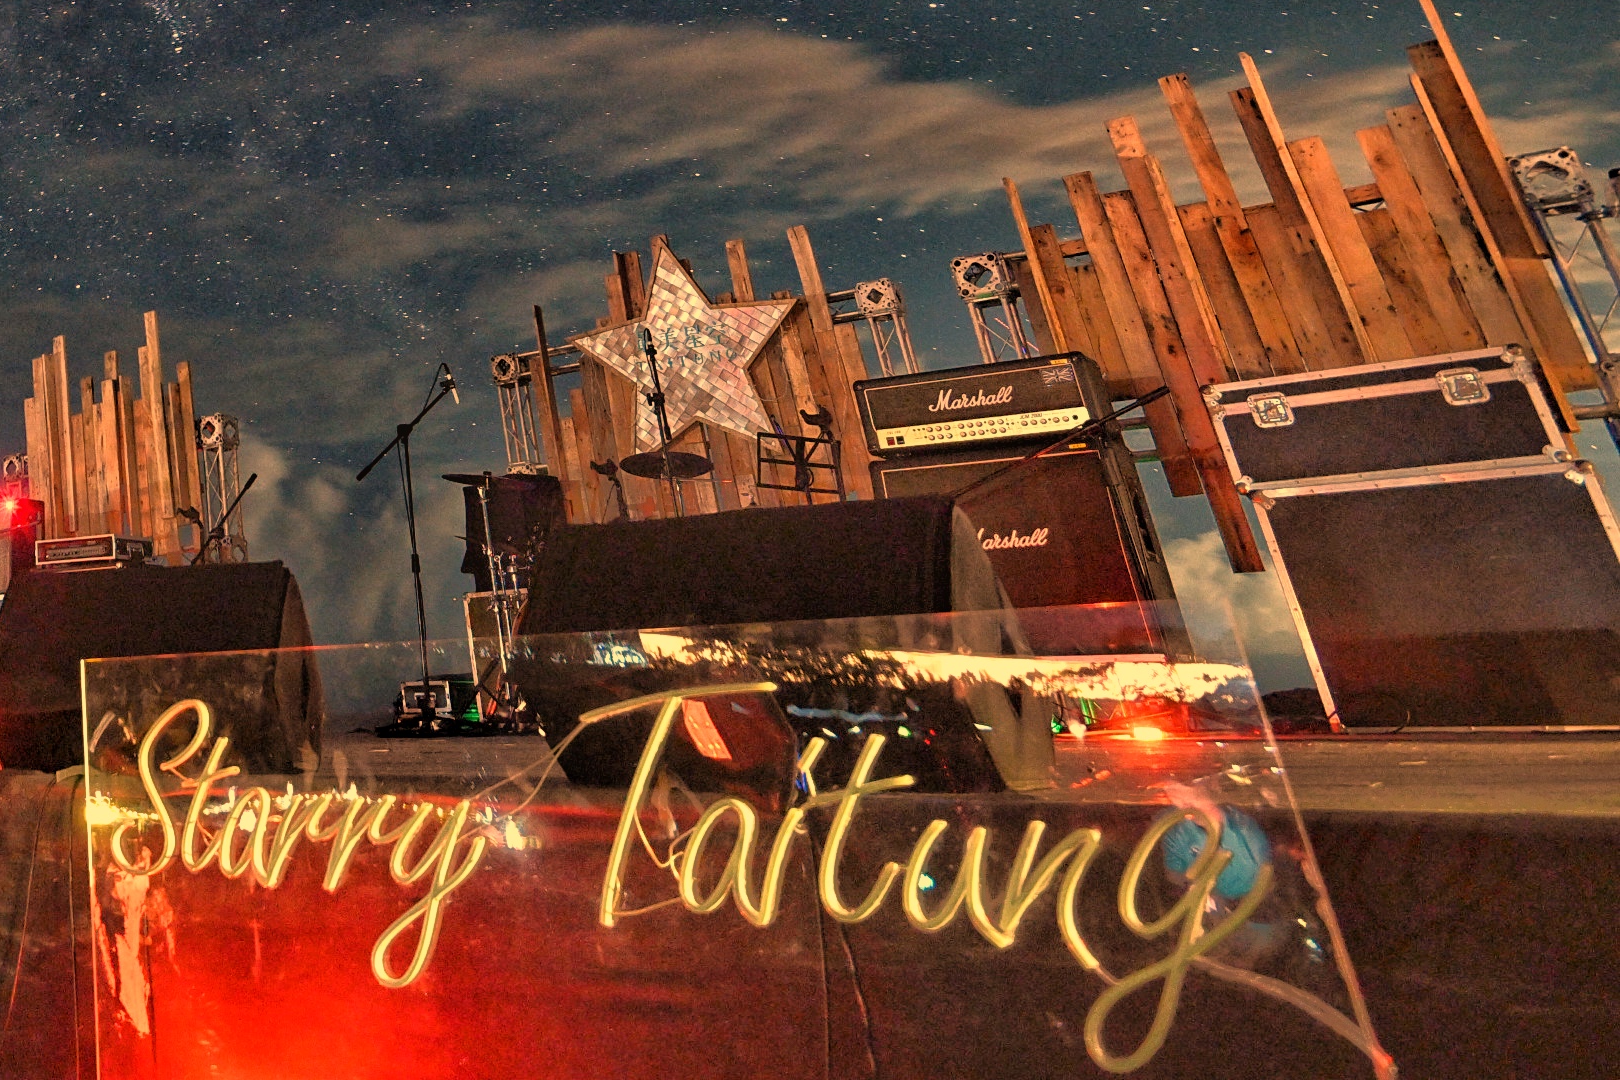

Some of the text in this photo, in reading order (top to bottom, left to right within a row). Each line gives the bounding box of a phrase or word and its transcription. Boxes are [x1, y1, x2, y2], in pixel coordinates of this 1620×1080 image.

[928, 385, 1013, 413] Marshall
[977, 527, 1049, 550] arshall
[111, 681, 1273, 1074] Starry Taitung
